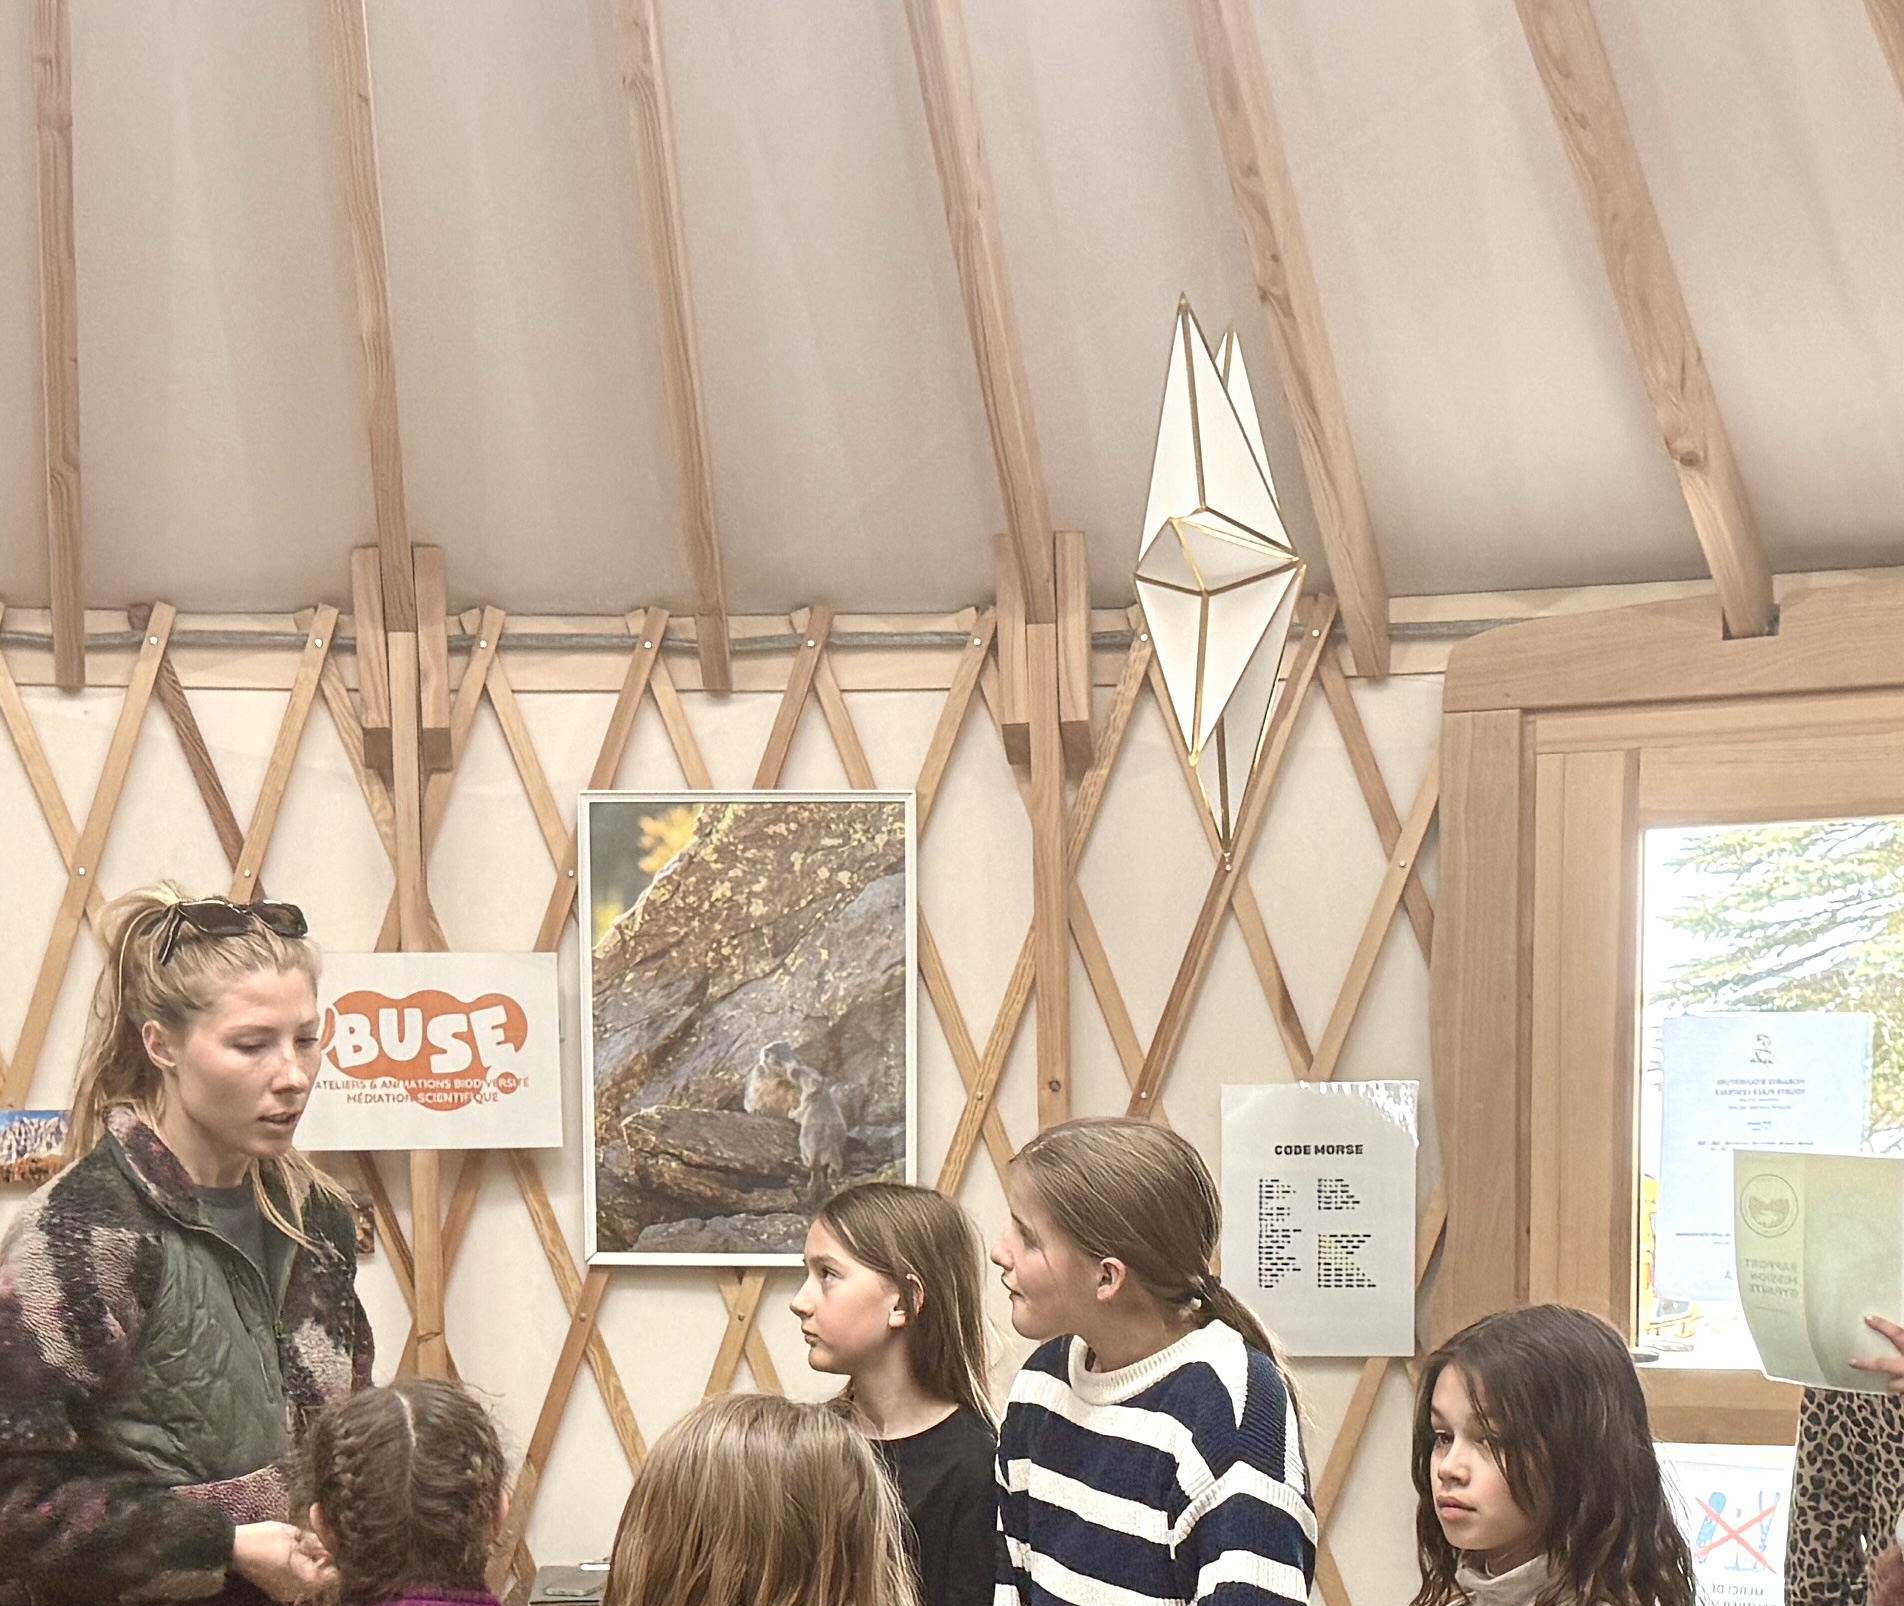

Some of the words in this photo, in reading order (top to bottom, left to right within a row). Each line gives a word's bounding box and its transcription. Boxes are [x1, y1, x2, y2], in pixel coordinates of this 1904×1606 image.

[334, 1004, 517, 1075] BUSE
[314, 1080, 366, 1091] ATELIERS
[380, 1078, 451, 1090] ANIMATIONS
[453, 1075, 529, 1089] BIODIVERSITÉ
[347, 1090, 414, 1104] MÉDIATION
[417, 1091, 499, 1104] SCIENTIFIQUE
[1274, 1144, 1312, 1156] CODE
[1313, 1144, 1364, 1156] MORSE
